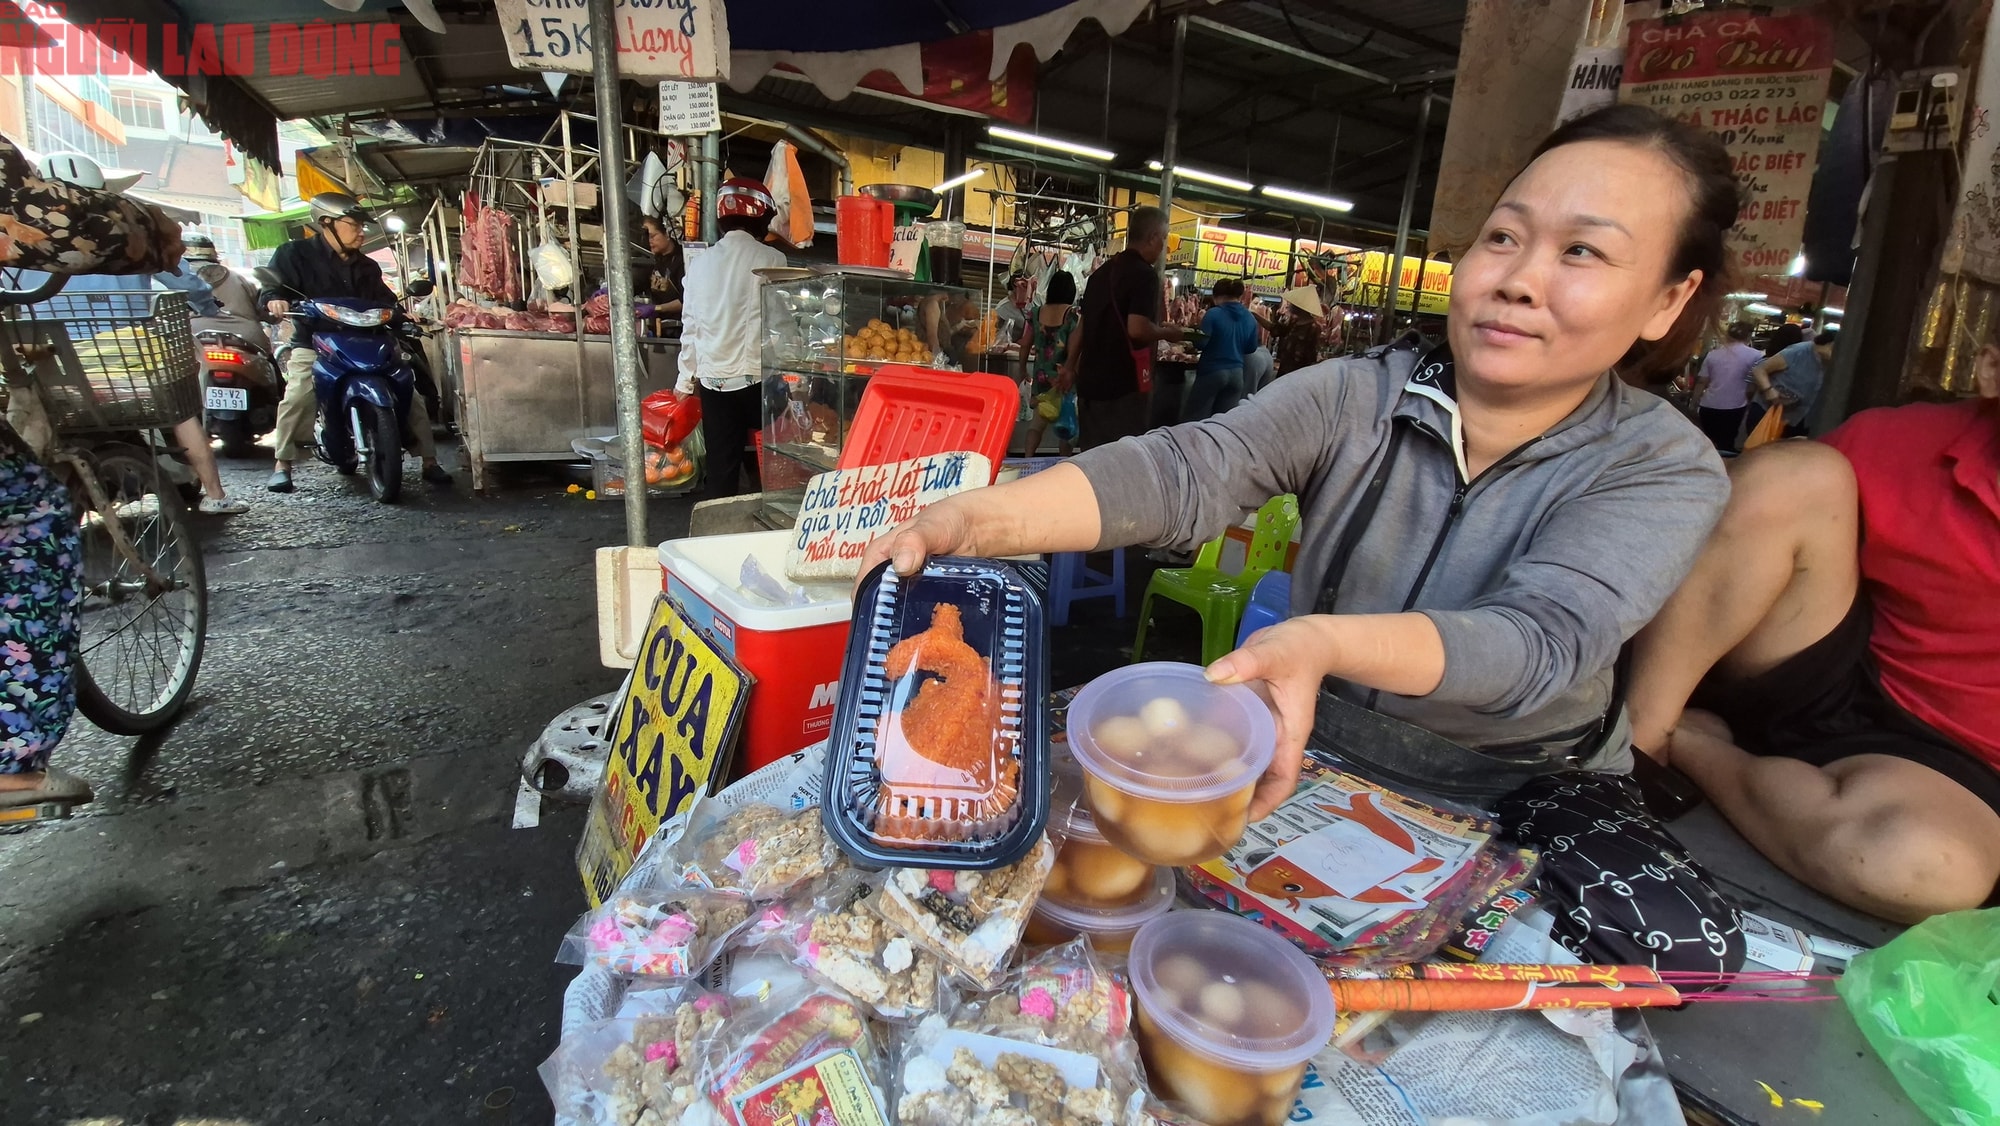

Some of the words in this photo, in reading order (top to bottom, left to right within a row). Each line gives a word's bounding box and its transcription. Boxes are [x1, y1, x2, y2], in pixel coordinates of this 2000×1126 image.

[627, 16, 694, 77] lạng
[1681, 91, 1723, 104] 0903
[1729, 89, 1761, 99] 022
[1766, 87, 1796, 98] 273
[1712, 104, 1768, 126] THÁC
[1776, 102, 1818, 123] LÁC
[1765, 150, 1806, 174] BIỆT
[1763, 196, 1800, 225] BIỆT
[1258, 251, 1284, 270] Trúc
[208, 399, 244, 409] 391.91
[805, 470, 838, 511] chả
[798, 512, 830, 550] gia
[836, 505, 852, 535] vị
[856, 497, 887, 530] Rồi
[645, 625, 713, 760] CUA
[619, 695, 695, 824] XAY
